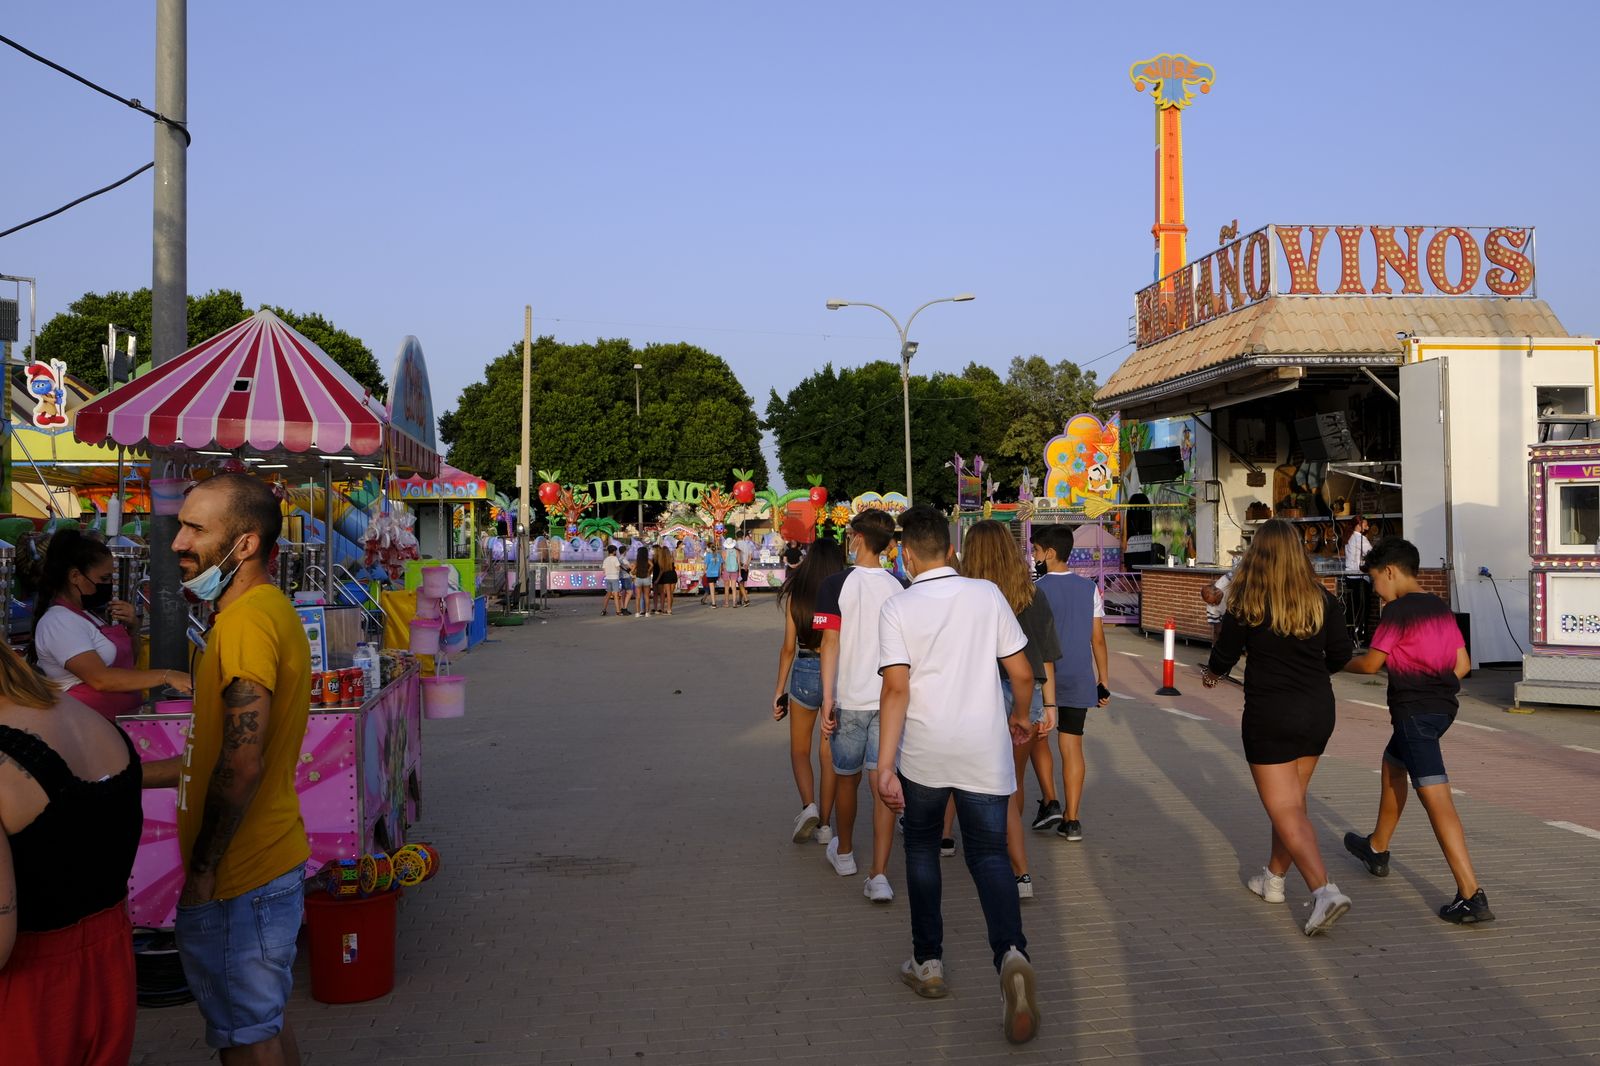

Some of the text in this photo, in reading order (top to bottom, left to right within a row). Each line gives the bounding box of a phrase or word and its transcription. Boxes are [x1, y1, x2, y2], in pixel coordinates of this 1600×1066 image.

[1142, 58, 1201, 80] NUBE
[1275, 226, 1534, 295] VINOS
[582, 479, 707, 504] USANO
[1561, 614, 1600, 633] DIS
